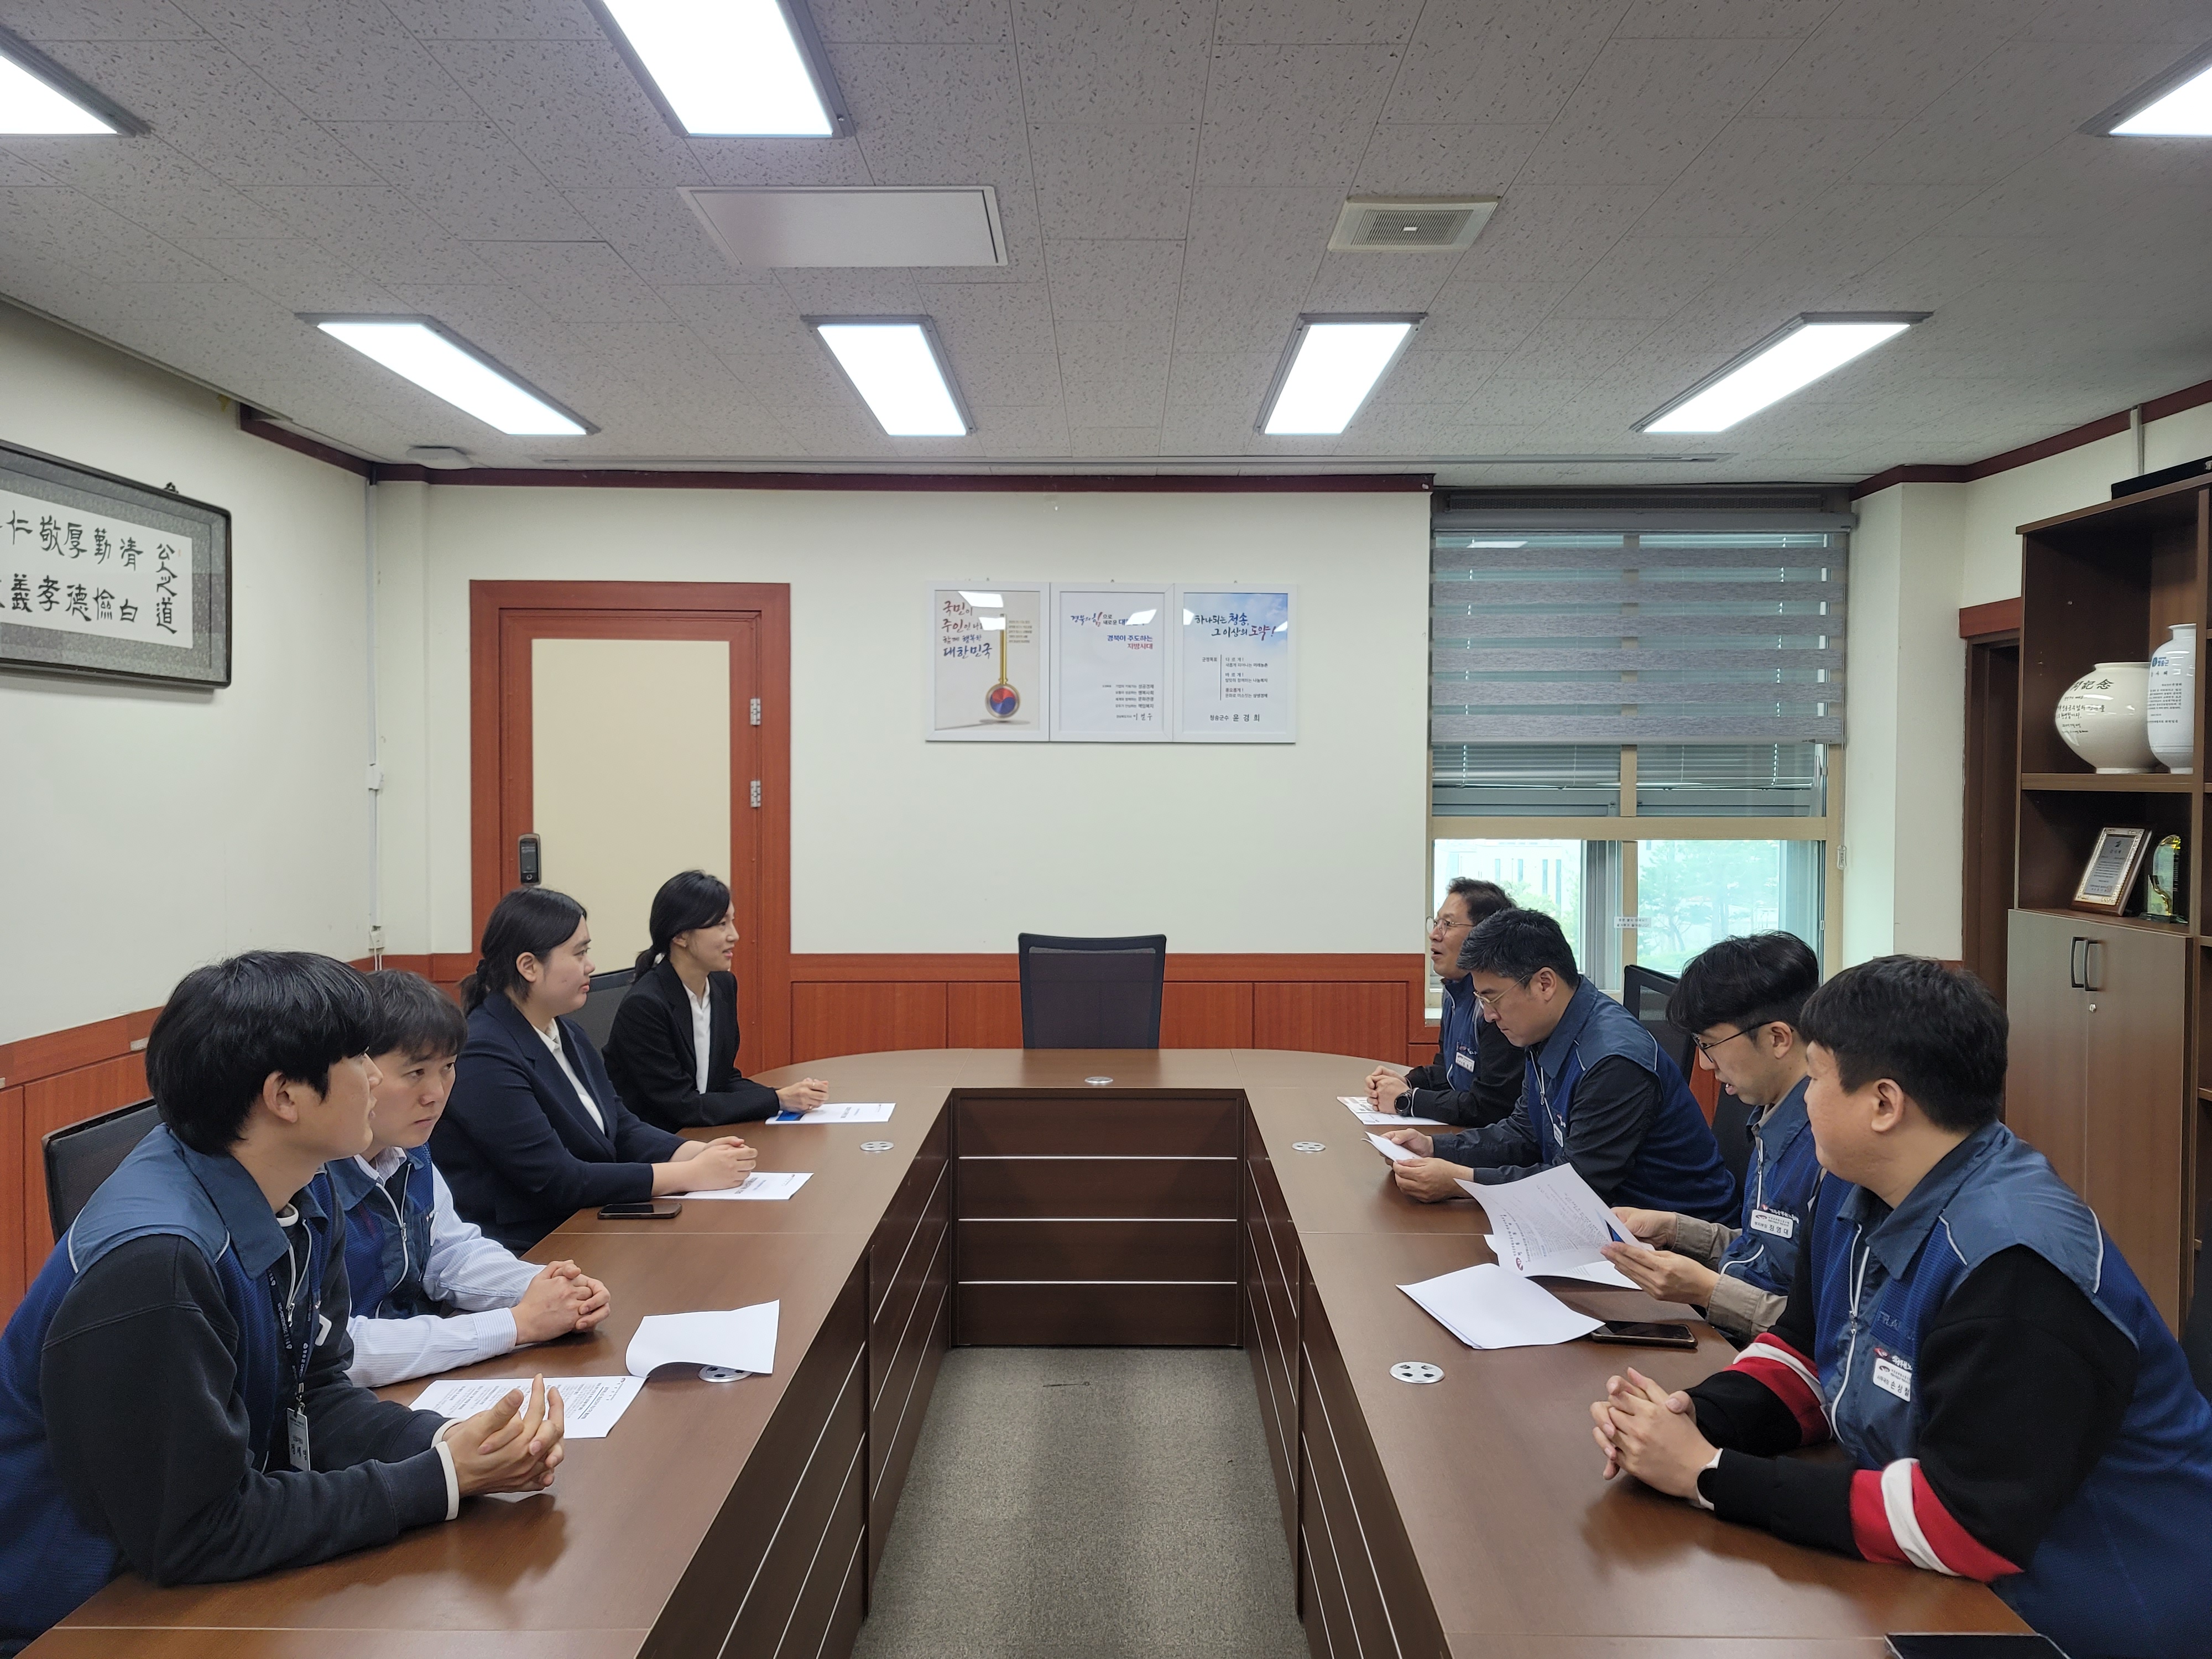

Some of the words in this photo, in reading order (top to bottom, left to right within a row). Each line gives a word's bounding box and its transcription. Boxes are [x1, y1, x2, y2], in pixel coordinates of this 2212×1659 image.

[942, 601, 973, 616] 국민이
[941, 618, 972, 633] 주인인
[1194, 614, 1227, 625] 하나되는
[943, 643, 992, 659] 대한민국
